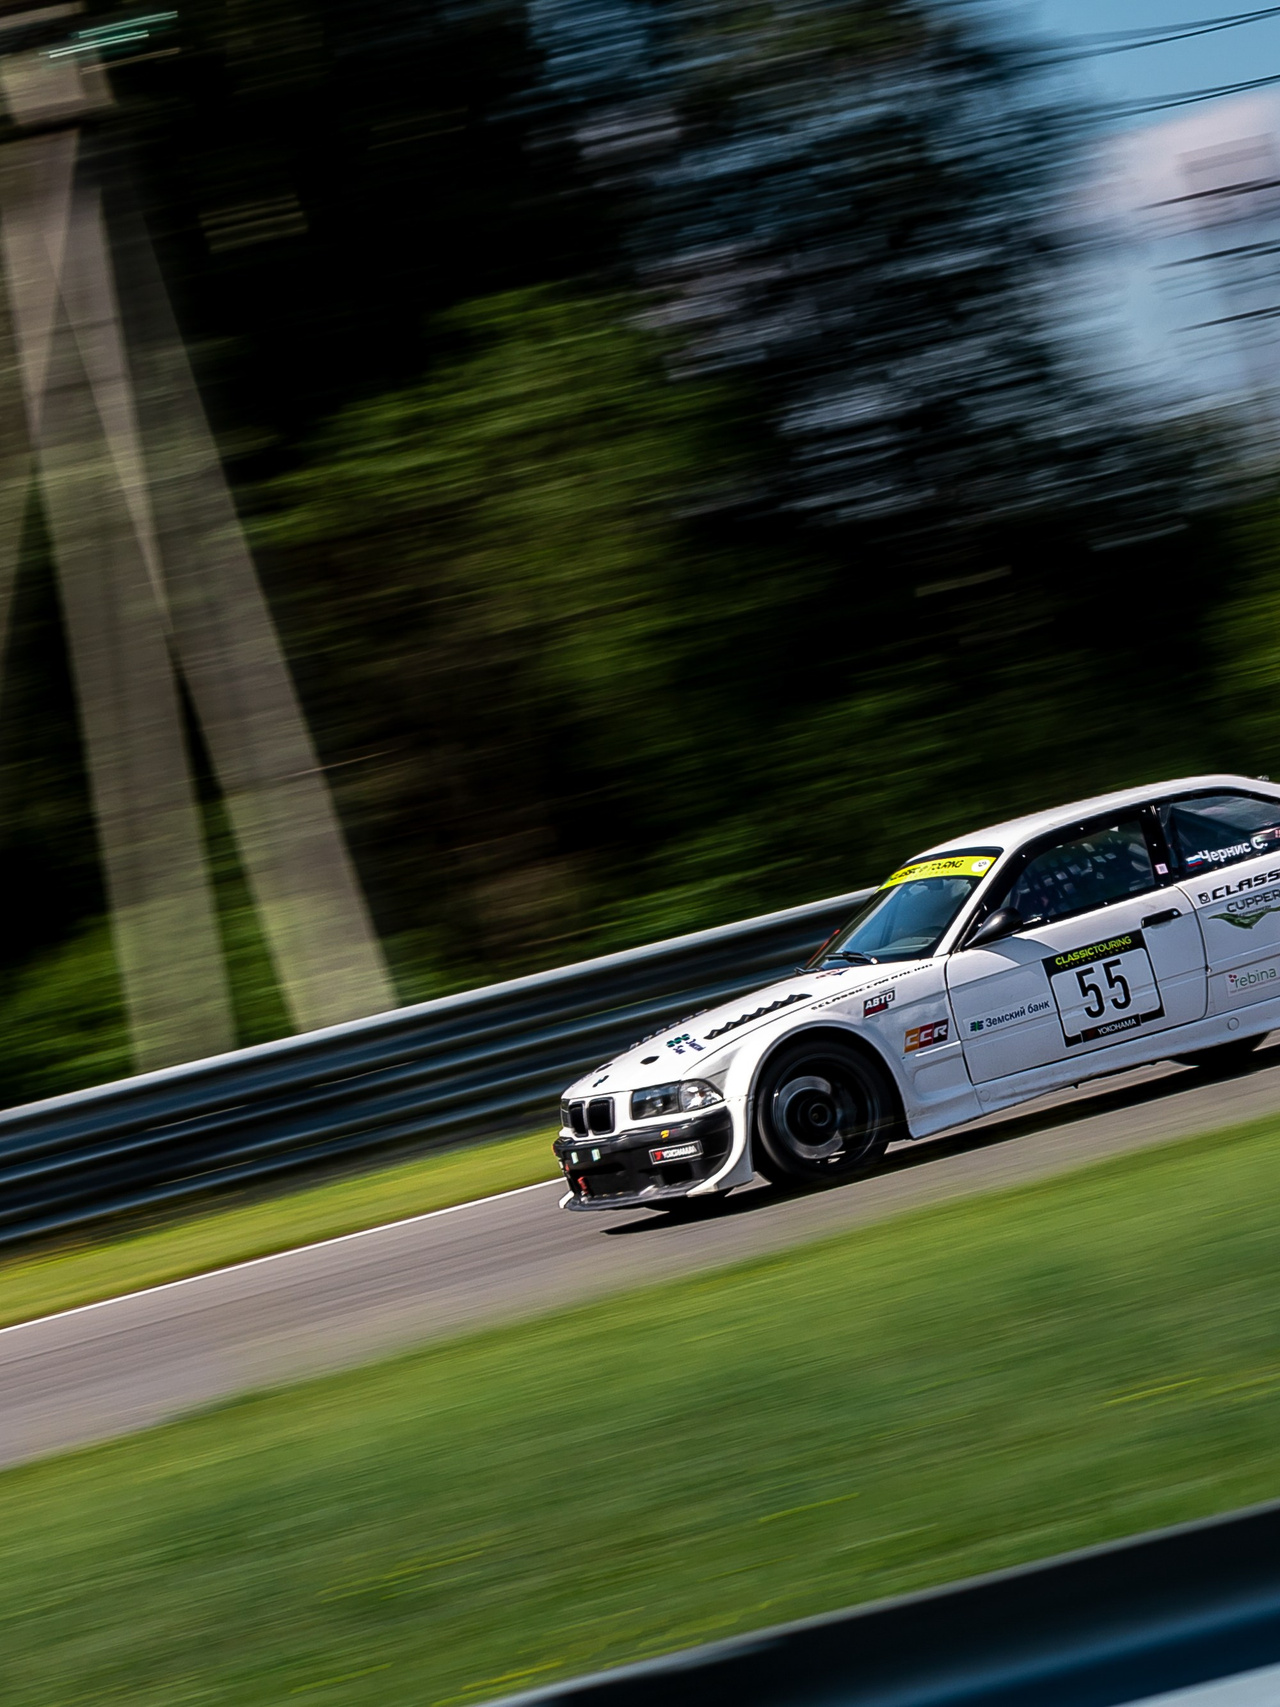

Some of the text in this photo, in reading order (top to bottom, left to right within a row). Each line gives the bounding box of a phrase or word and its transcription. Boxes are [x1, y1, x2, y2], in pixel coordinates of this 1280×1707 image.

[1198, 842, 1252, 863] Чернис
[1075, 958, 1132, 1018] 55
[1235, 968, 1277, 988] rebina
[865, 992, 894, 1010] АВТО
[985, 1000, 1051, 1028] Земский банк
[906, 1026, 948, 1045] CCR
[1098, 1018, 1137, 1035] YOKOHAMA
